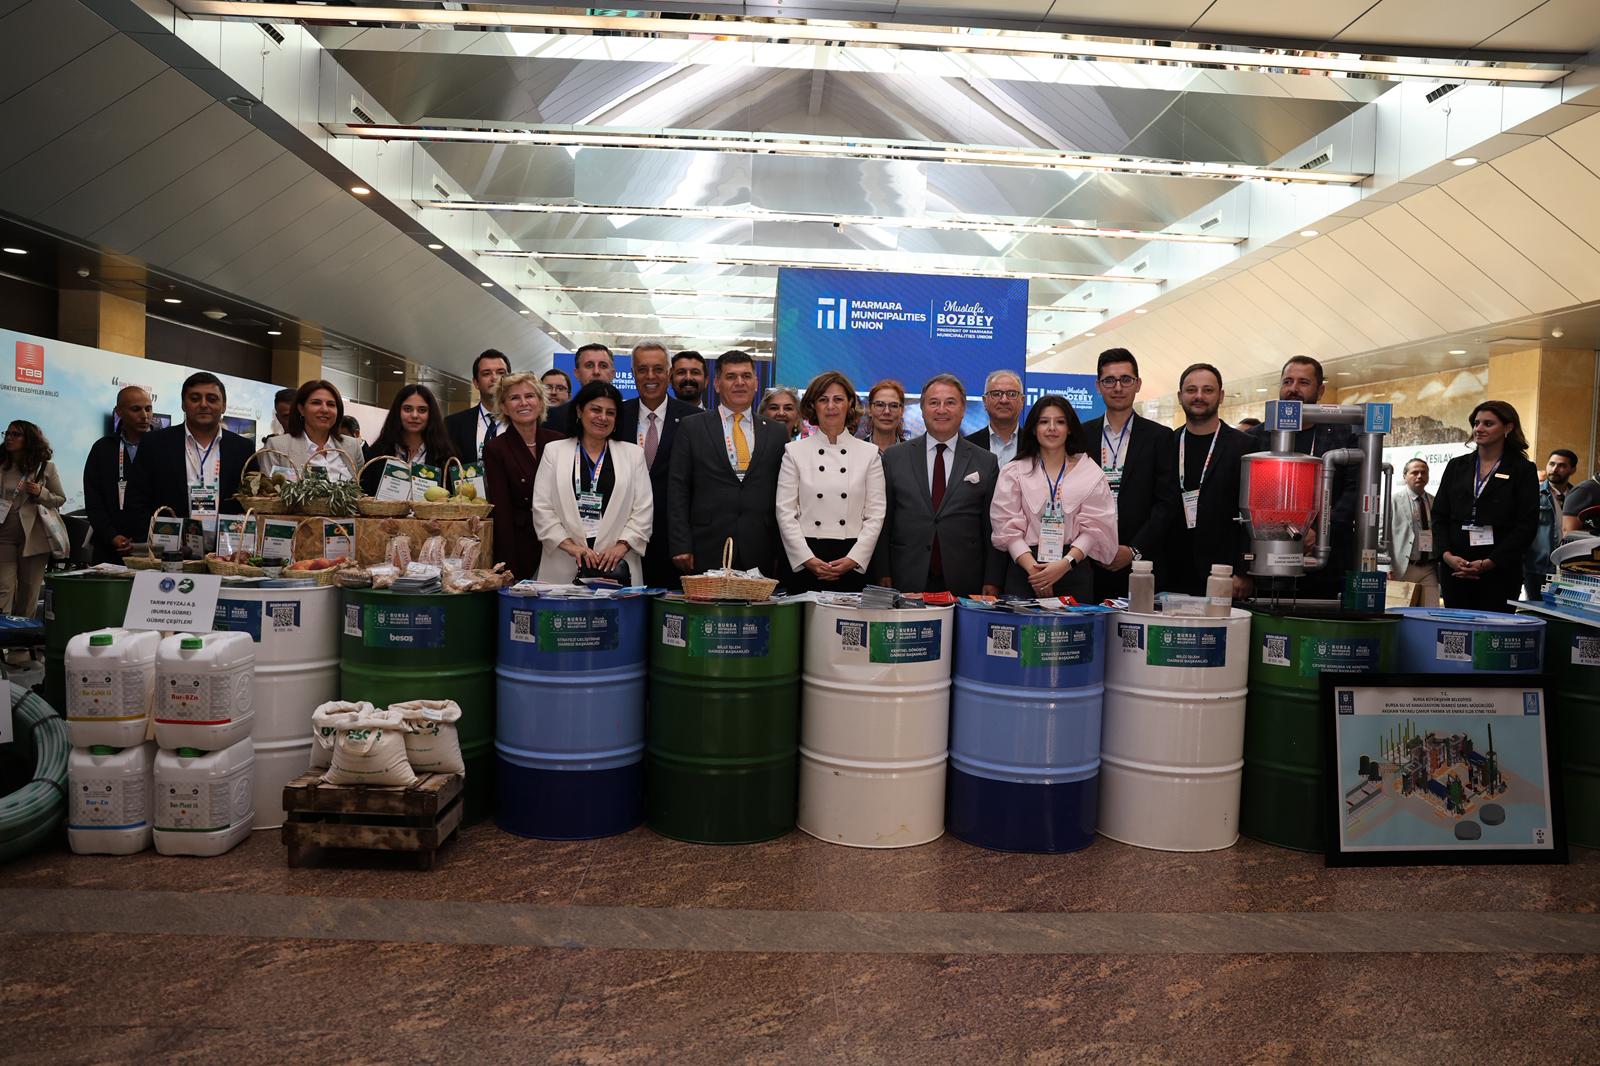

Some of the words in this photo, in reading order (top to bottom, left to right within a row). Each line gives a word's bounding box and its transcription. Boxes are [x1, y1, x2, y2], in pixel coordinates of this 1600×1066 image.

[852, 300, 902, 311] MARMARA
[943, 300, 985, 315] Mustafa
[851, 310, 927, 323] MUNICIPALITIES
[937, 313, 994, 327] BOZBEY
[851, 321, 884, 330] UNION
[17, 366, 42, 378] TBB
[389, 632, 414, 642] besaş
